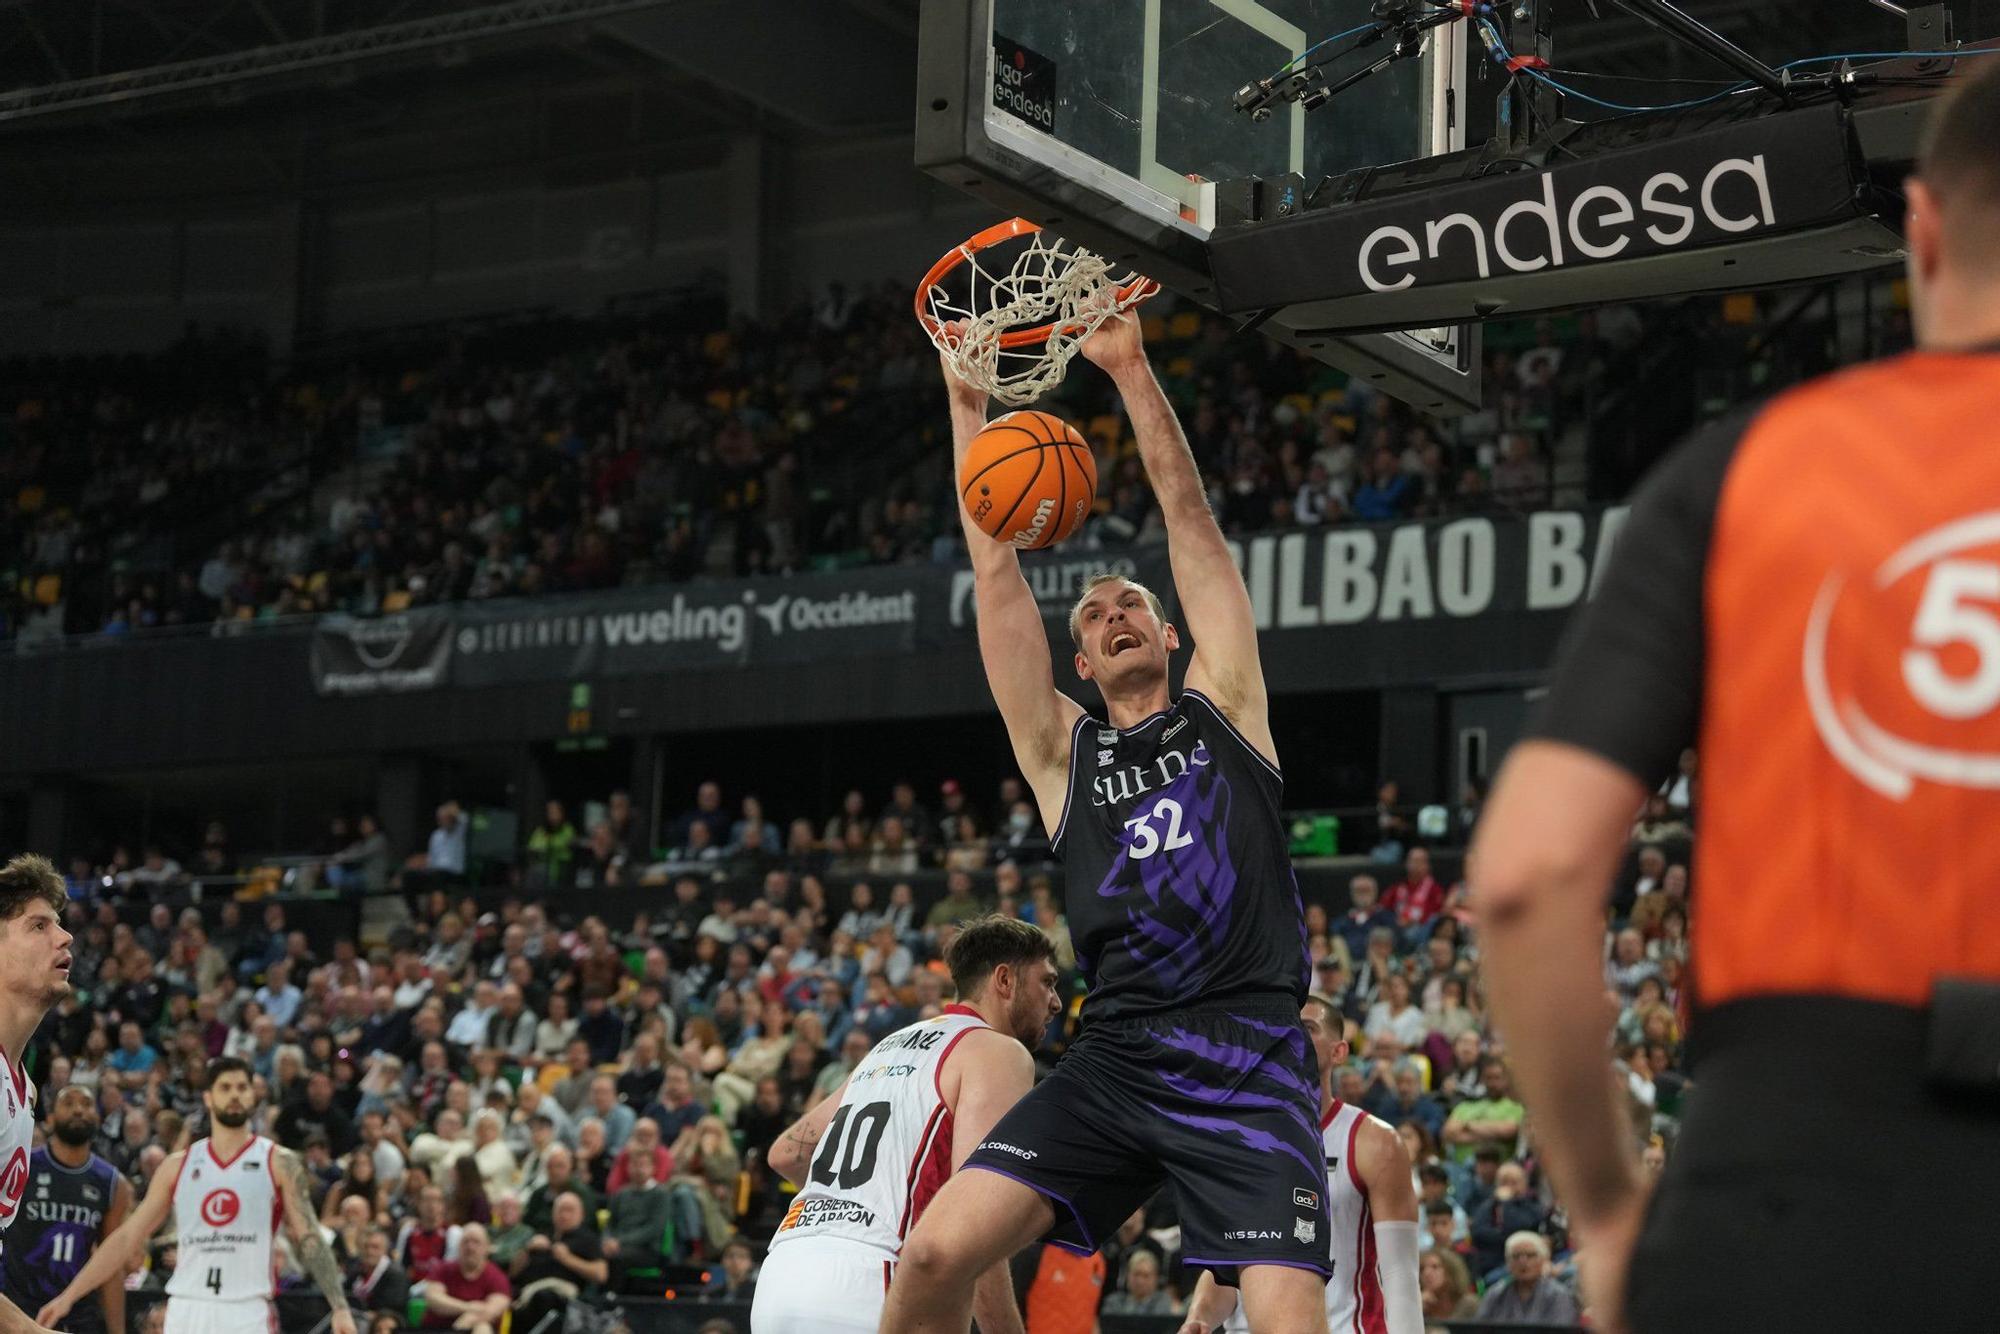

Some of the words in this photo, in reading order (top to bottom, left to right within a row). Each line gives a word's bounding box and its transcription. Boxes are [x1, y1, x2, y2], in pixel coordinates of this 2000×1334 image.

[994, 83, 1052, 127] endesa
[1358, 154, 1776, 293] endesa
[1028, 558, 1137, 600] urne
[1226, 516, 1496, 631] ILBAO
[603, 591, 747, 652] vueling
[788, 590, 915, 630] Occident
[1902, 558, 2000, 720] 5
[1092, 738, 1210, 807] surne
[1124, 797, 1194, 860] 32
[811, 1101, 891, 1190] 10
[987, 1141, 1032, 1160] CORREO
[26, 1200, 102, 1229] surne
[796, 1213, 815, 1227] DE
[1296, 1195, 1314, 1206] acb
[53, 1232, 75, 1263] 11
[1224, 1230, 1282, 1240] NISSAN
[206, 1266, 222, 1295] 4
